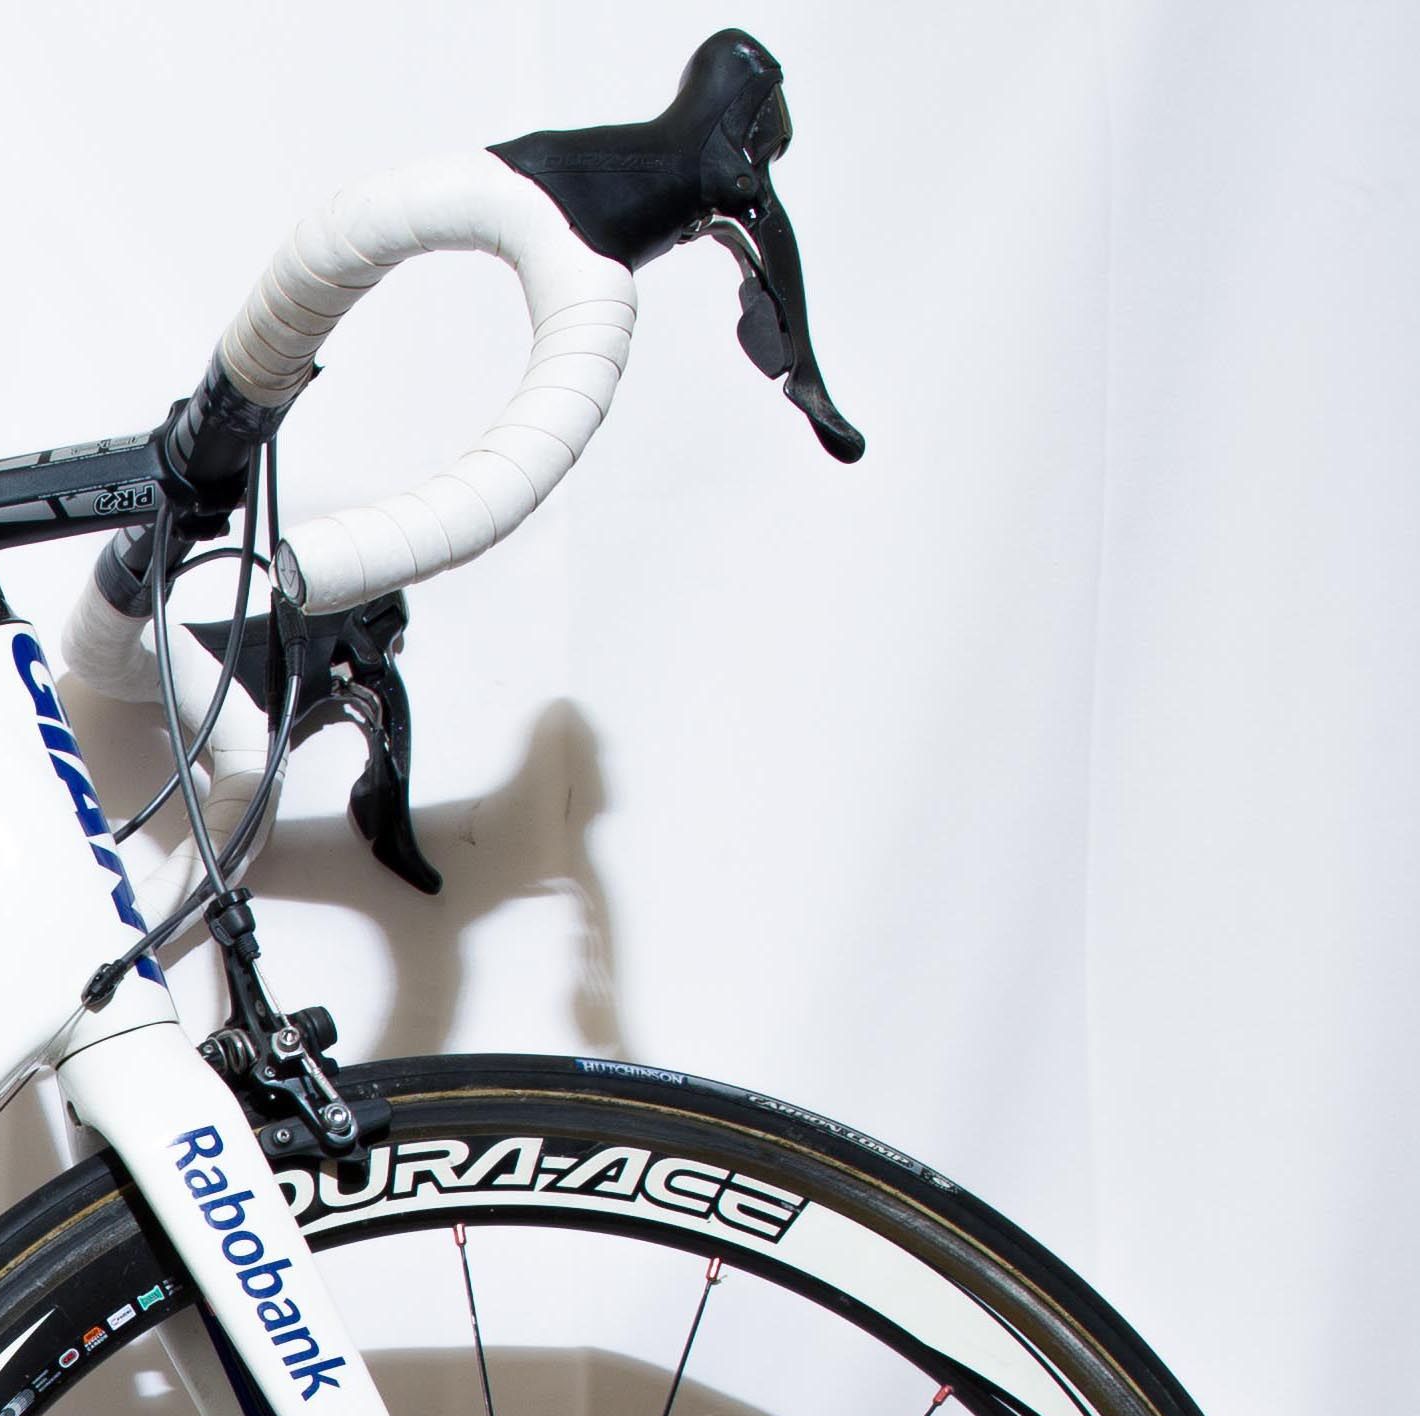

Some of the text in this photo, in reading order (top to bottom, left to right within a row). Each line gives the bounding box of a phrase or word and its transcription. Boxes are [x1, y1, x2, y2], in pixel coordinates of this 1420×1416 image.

[581, 1060, 686, 1086] HUTCHINSON
[273, 1136, 809, 1242] DURA-ACE
[166, 1124, 347, 1402] Rabobank
